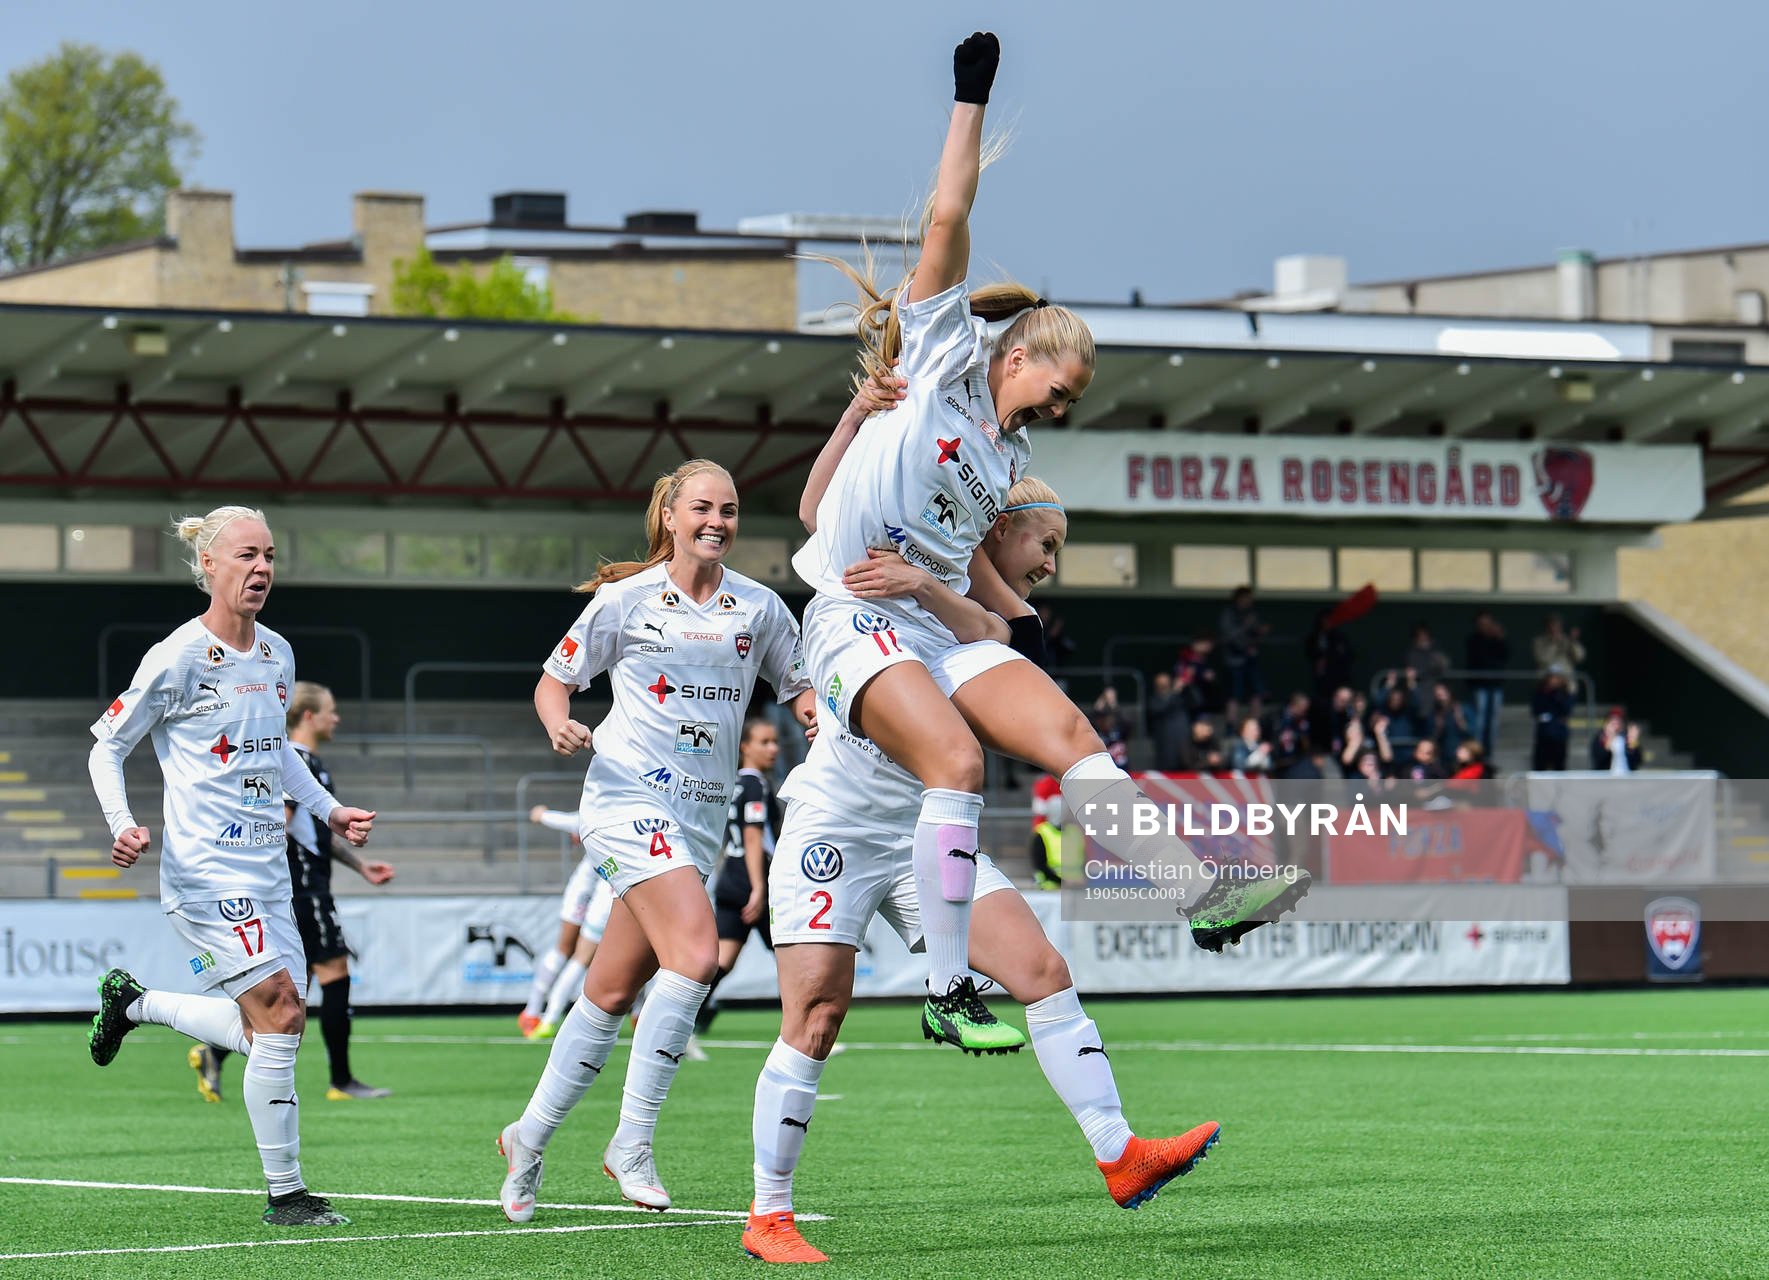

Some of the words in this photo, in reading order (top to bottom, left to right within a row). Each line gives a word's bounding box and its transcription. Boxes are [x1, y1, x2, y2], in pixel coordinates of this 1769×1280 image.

[1127, 454, 1261, 501] FORZA
[1281, 446, 1521, 507] ROSENGÅRD
[640, 644, 674, 654] stadium
[680, 789, 693, 801] of
[694, 791, 727, 806] Sharing
[682, 776, 725, 793] Embassy
[649, 832, 672, 860] 4
[808, 890, 833, 930] 2
[232, 918, 264, 958] 17
[1094, 922, 1180, 960] EXPECT
